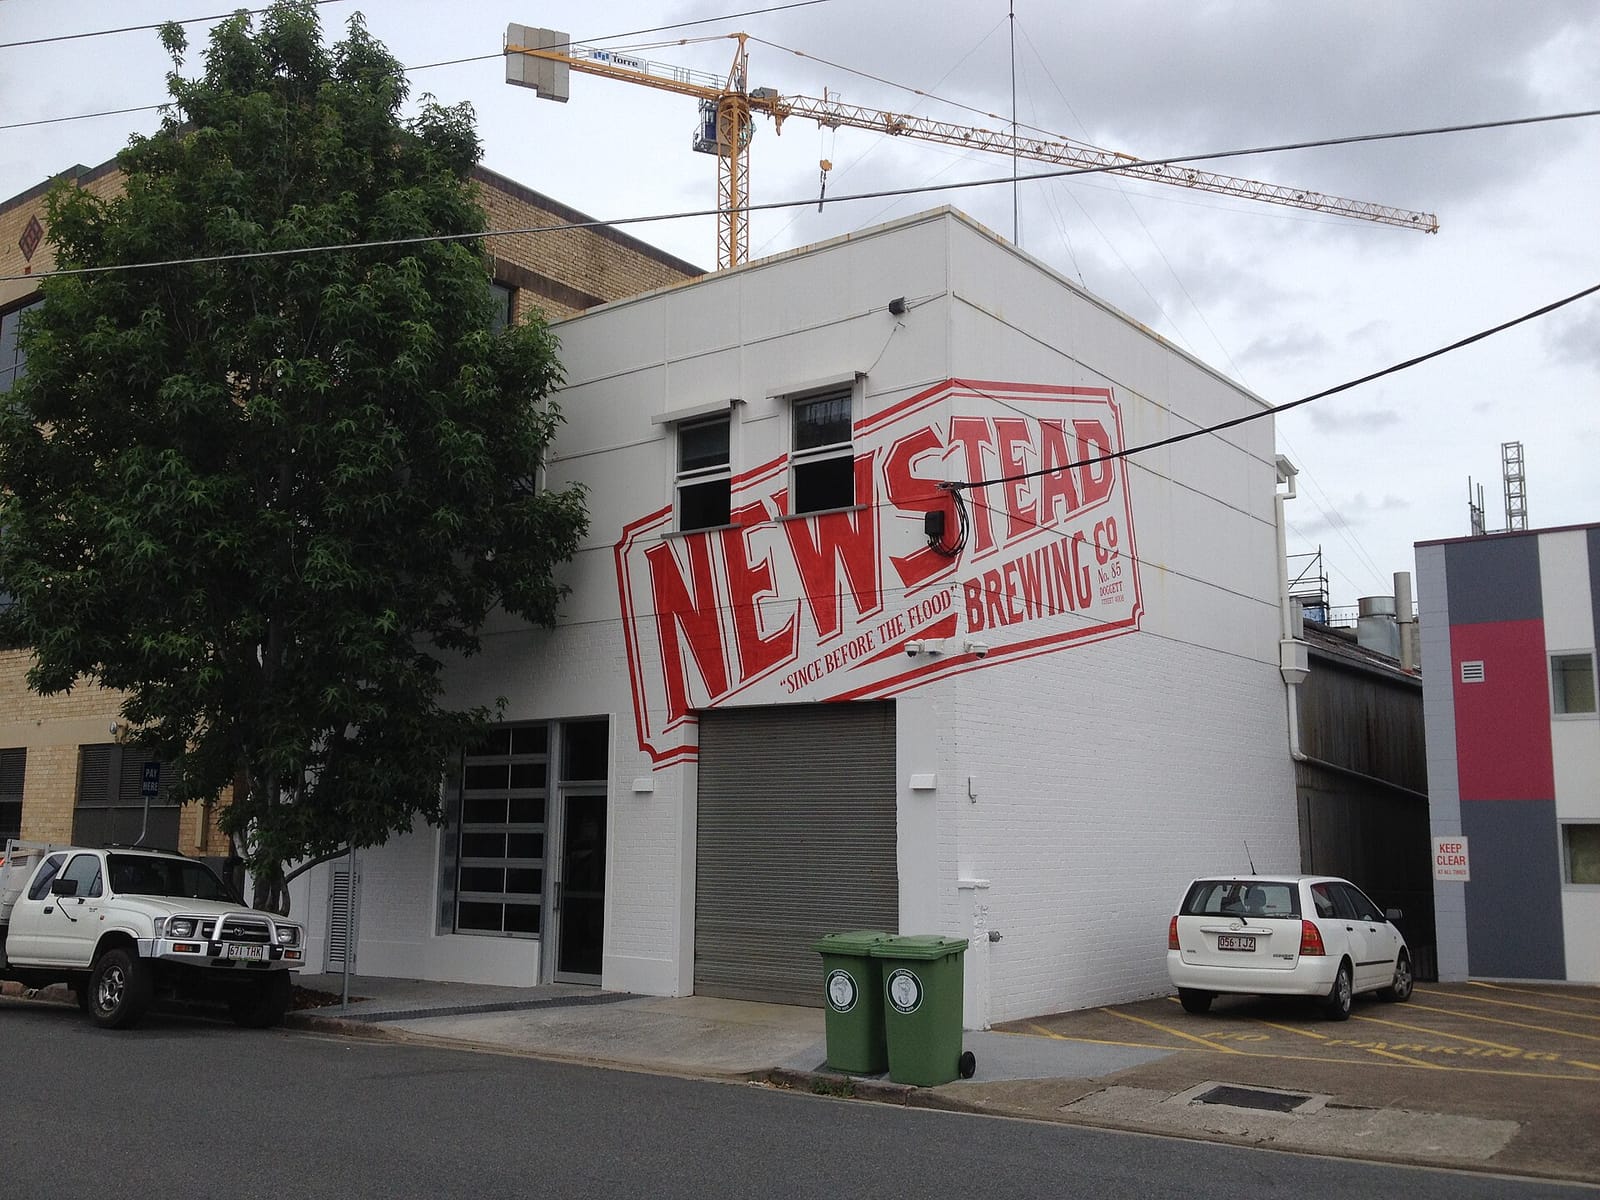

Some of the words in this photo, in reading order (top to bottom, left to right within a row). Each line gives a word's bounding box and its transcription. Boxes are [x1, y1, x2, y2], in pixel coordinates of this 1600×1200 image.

[612, 55, 638, 67] Torre
[645, 416, 1118, 726] NEWSTEAD
[1110, 561, 1121, 579] 85
[963, 530, 1092, 634] BREWING
[825, 630, 876, 674] BEFORE
[877, 613, 907, 645] THE
[145, 768, 158, 778] PAY
[143, 781, 158, 792] HERE
[1439, 843, 1462, 853] KEEP
[1436, 855, 1466, 866] CLEAR
[1199, 1031, 1270, 1041] NO
[1323, 1039, 1561, 1061] PARKING
